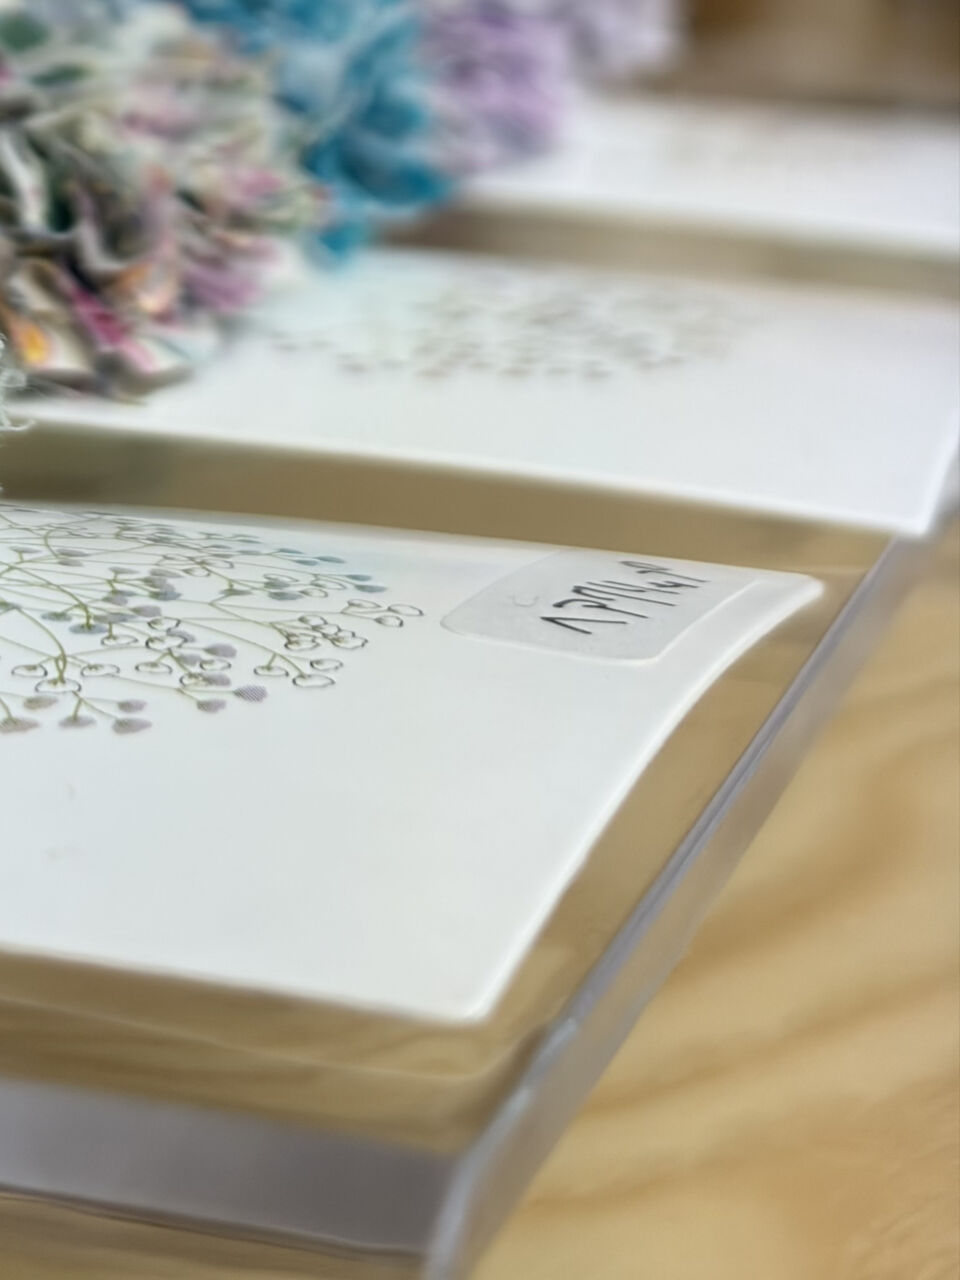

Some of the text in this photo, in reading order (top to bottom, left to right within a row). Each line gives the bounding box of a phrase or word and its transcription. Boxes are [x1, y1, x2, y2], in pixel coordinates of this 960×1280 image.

[539, 560, 711, 634] ヘアクリップ
